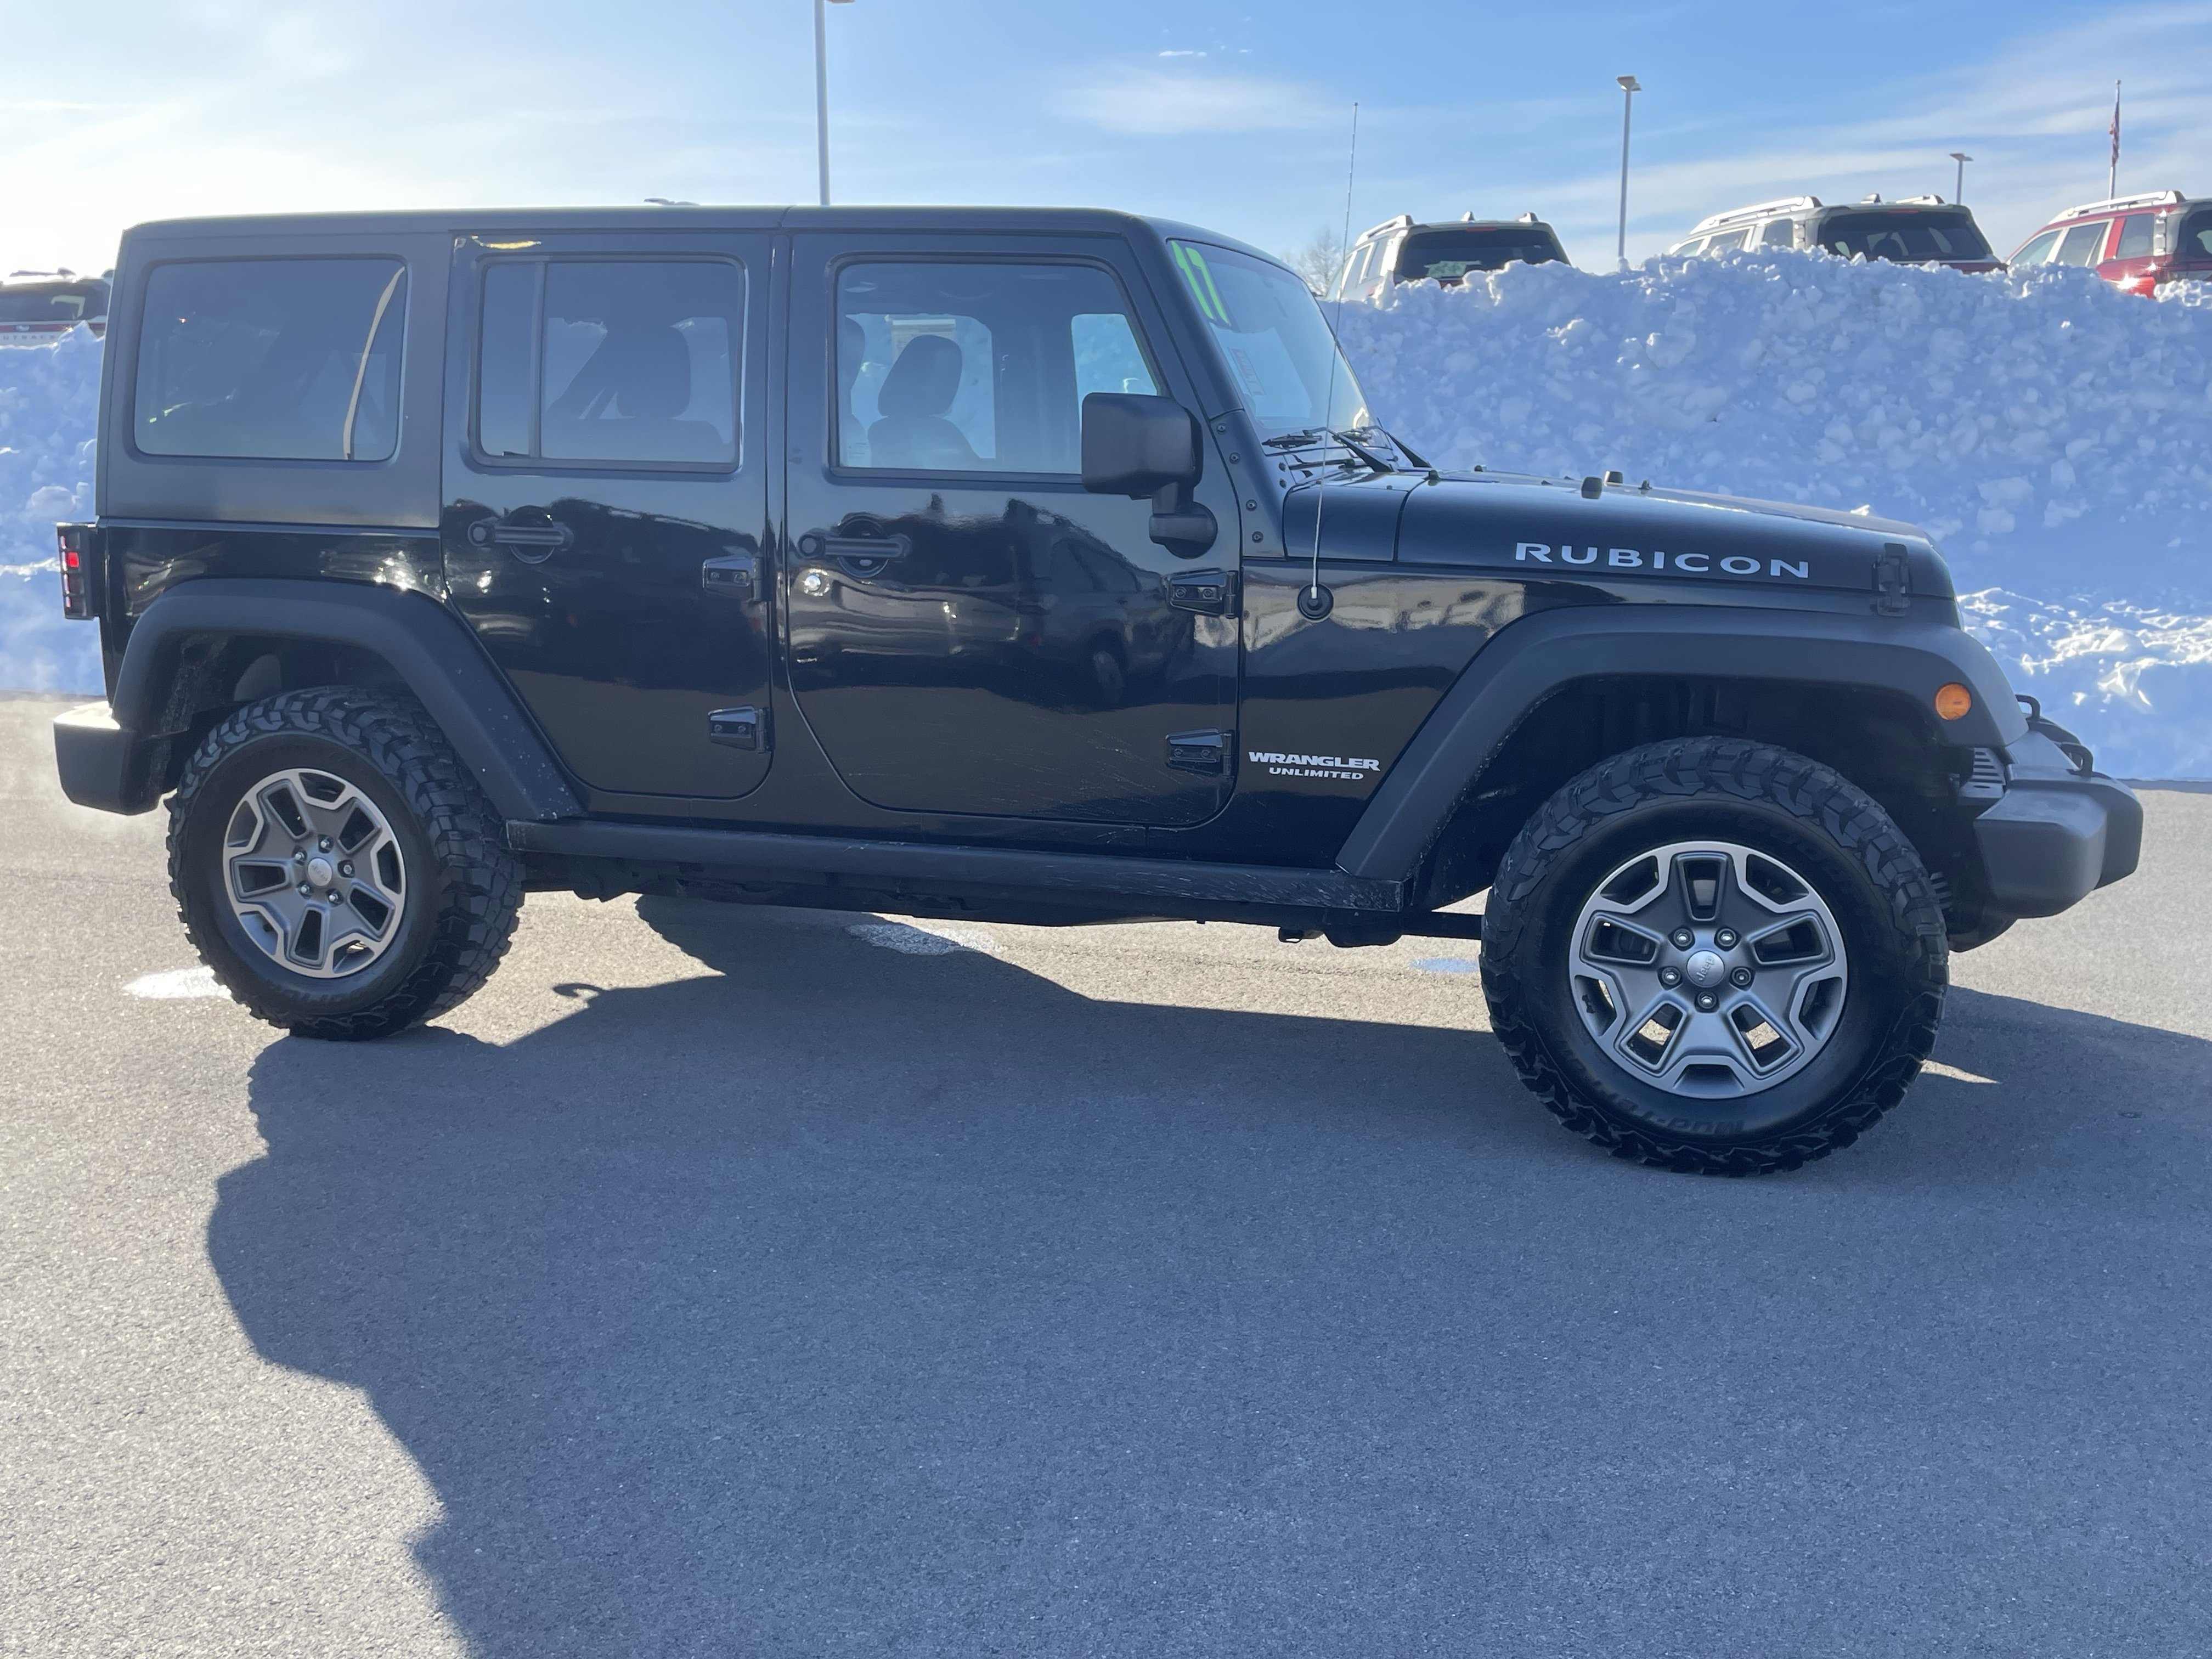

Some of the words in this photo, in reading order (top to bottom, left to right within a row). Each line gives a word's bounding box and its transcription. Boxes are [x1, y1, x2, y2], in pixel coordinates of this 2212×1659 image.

[1515, 542, 1809, 578] RUBICON
[1248, 752, 1381, 771] WRANGLER
[1268, 767, 1364, 780] UNLIMITED
[1696, 956, 1714, 980] Jeep
